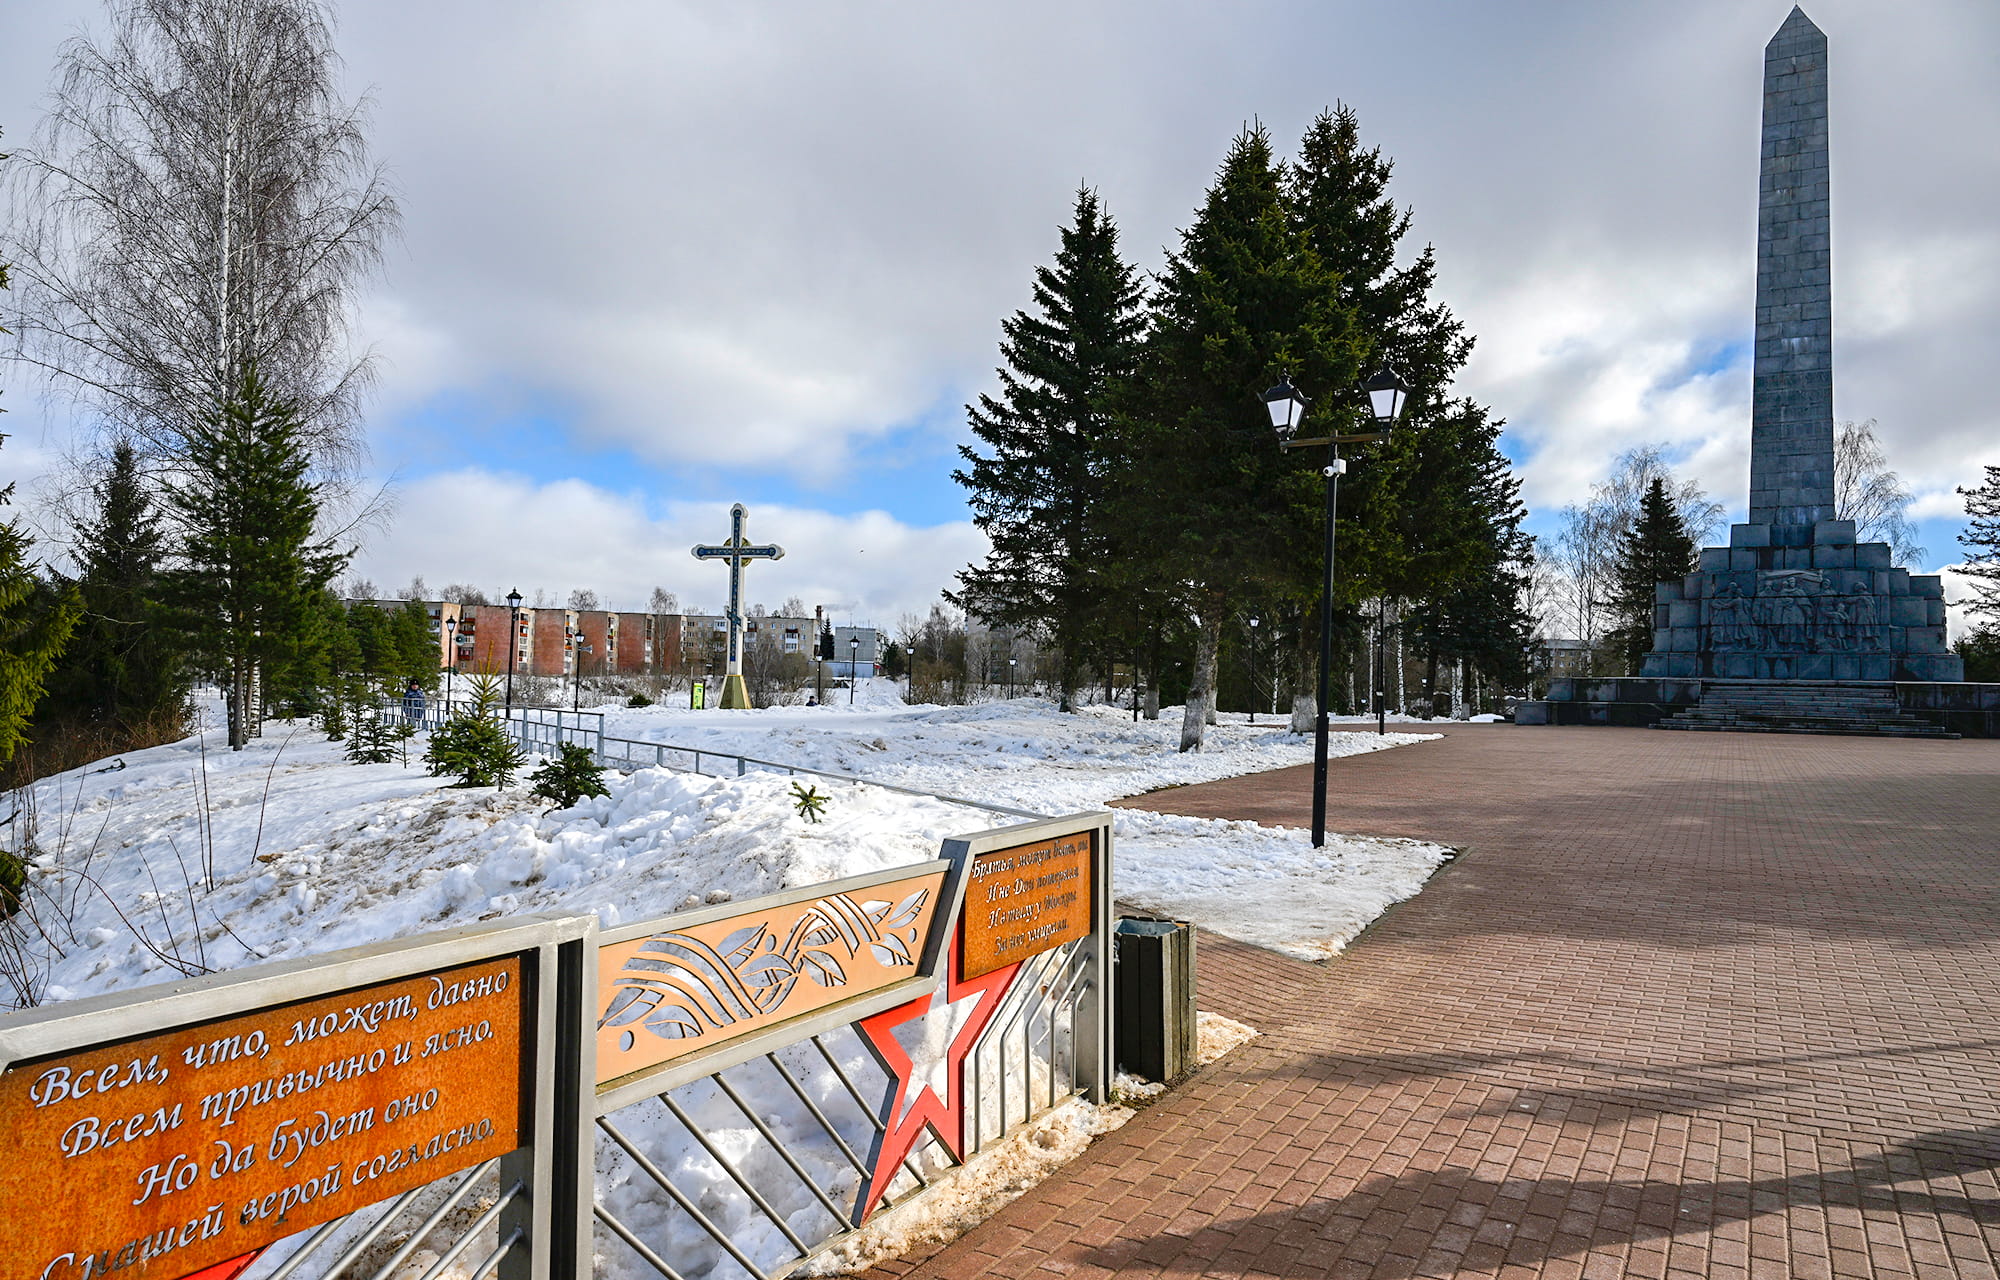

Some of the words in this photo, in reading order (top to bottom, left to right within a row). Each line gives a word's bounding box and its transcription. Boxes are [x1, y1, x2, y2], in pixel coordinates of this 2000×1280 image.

[971, 857, 1015, 883] Братья,
[985, 882, 1000, 903] И
[999, 885, 1010, 898] не
[1013, 878, 1035, 896] Дон
[1036, 866, 1079, 889] потеряли
[987, 907, 1001, 929] И
[1007, 904, 1035, 923] тылу
[1033, 902, 1042, 920] у
[1043, 890, 1077, 912] Москвы
[994, 935, 1008, 956] За
[30, 1054, 169, 1109] Всем,
[182, 1028, 271, 1070] что,
[284, 994, 420, 1049] может,
[426, 970, 510, 1011] давно
[60, 1102, 184, 1159] Всем
[199, 1047, 387, 1128] привычно
[393, 1041, 414, 1067] и
[421, 1018, 495, 1058] ясно.
[132, 1152, 198, 1206] Но
[210, 1140, 256, 1182] да
[267, 1109, 376, 1169] будет
[384, 1087, 439, 1123] оно
[80, 1201, 226, 1280] нашей
[239, 1163, 342, 1226] верой
[351, 1116, 495, 1187] согласно.
